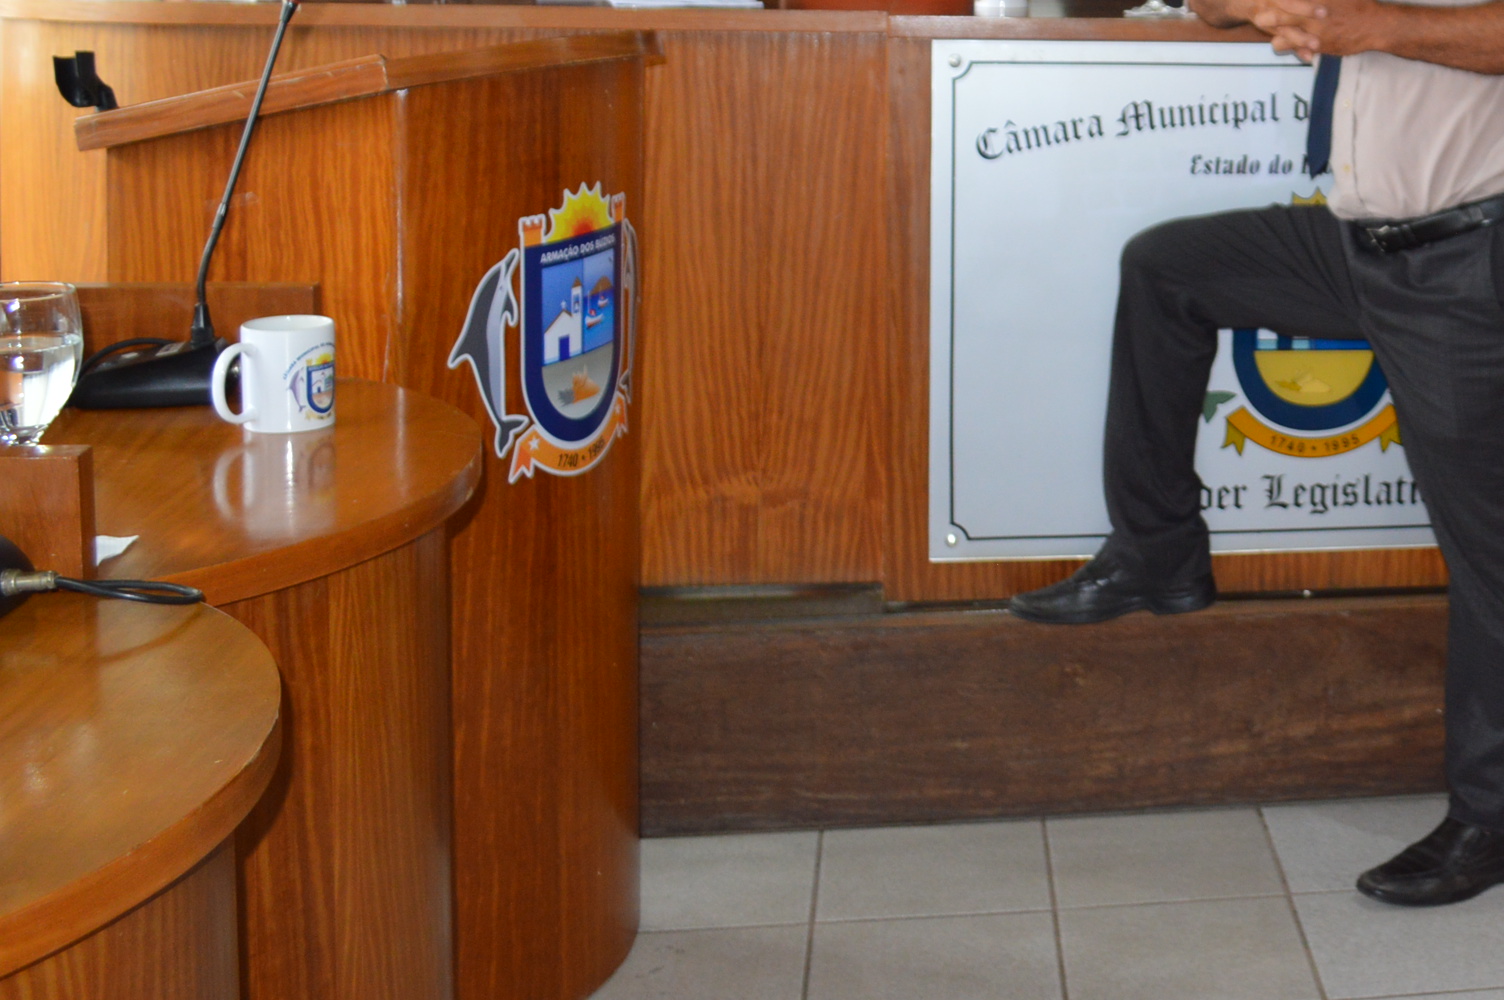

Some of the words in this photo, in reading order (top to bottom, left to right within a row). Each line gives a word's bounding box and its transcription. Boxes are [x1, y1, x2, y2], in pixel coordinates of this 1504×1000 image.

[976, 114, 1105, 160] Câmara
[1115, 92, 1280, 137] Municipal
[1189, 153, 1261, 175] Estado
[1267, 153, 1293, 175] do
[580, 240, 595, 255] DOS
[557, 452, 579, 468] 1740
[1199, 483, 1248, 510] der
[1261, 472, 1419, 515] Legislati
